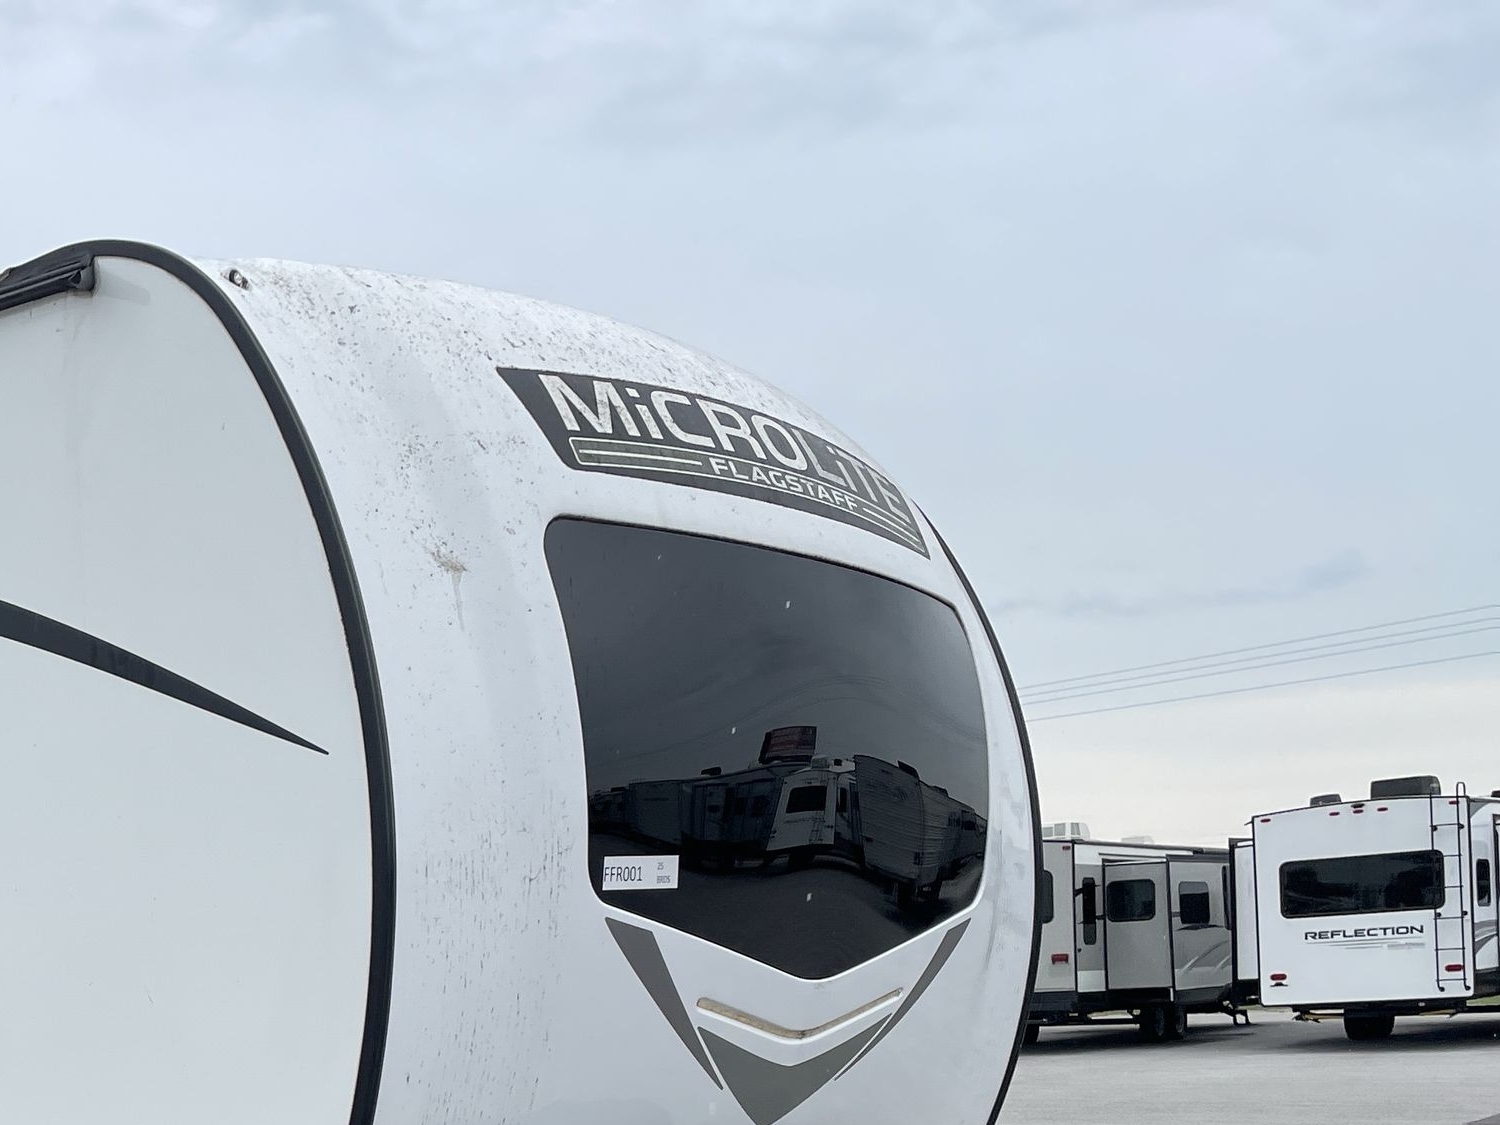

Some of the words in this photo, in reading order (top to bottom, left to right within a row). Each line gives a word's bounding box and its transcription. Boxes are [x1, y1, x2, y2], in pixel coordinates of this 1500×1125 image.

[709, 456, 858, 511] FLAGSTAFF
[603, 866, 643, 882] FFR001
[1304, 925, 1424, 940] REFLECTION
